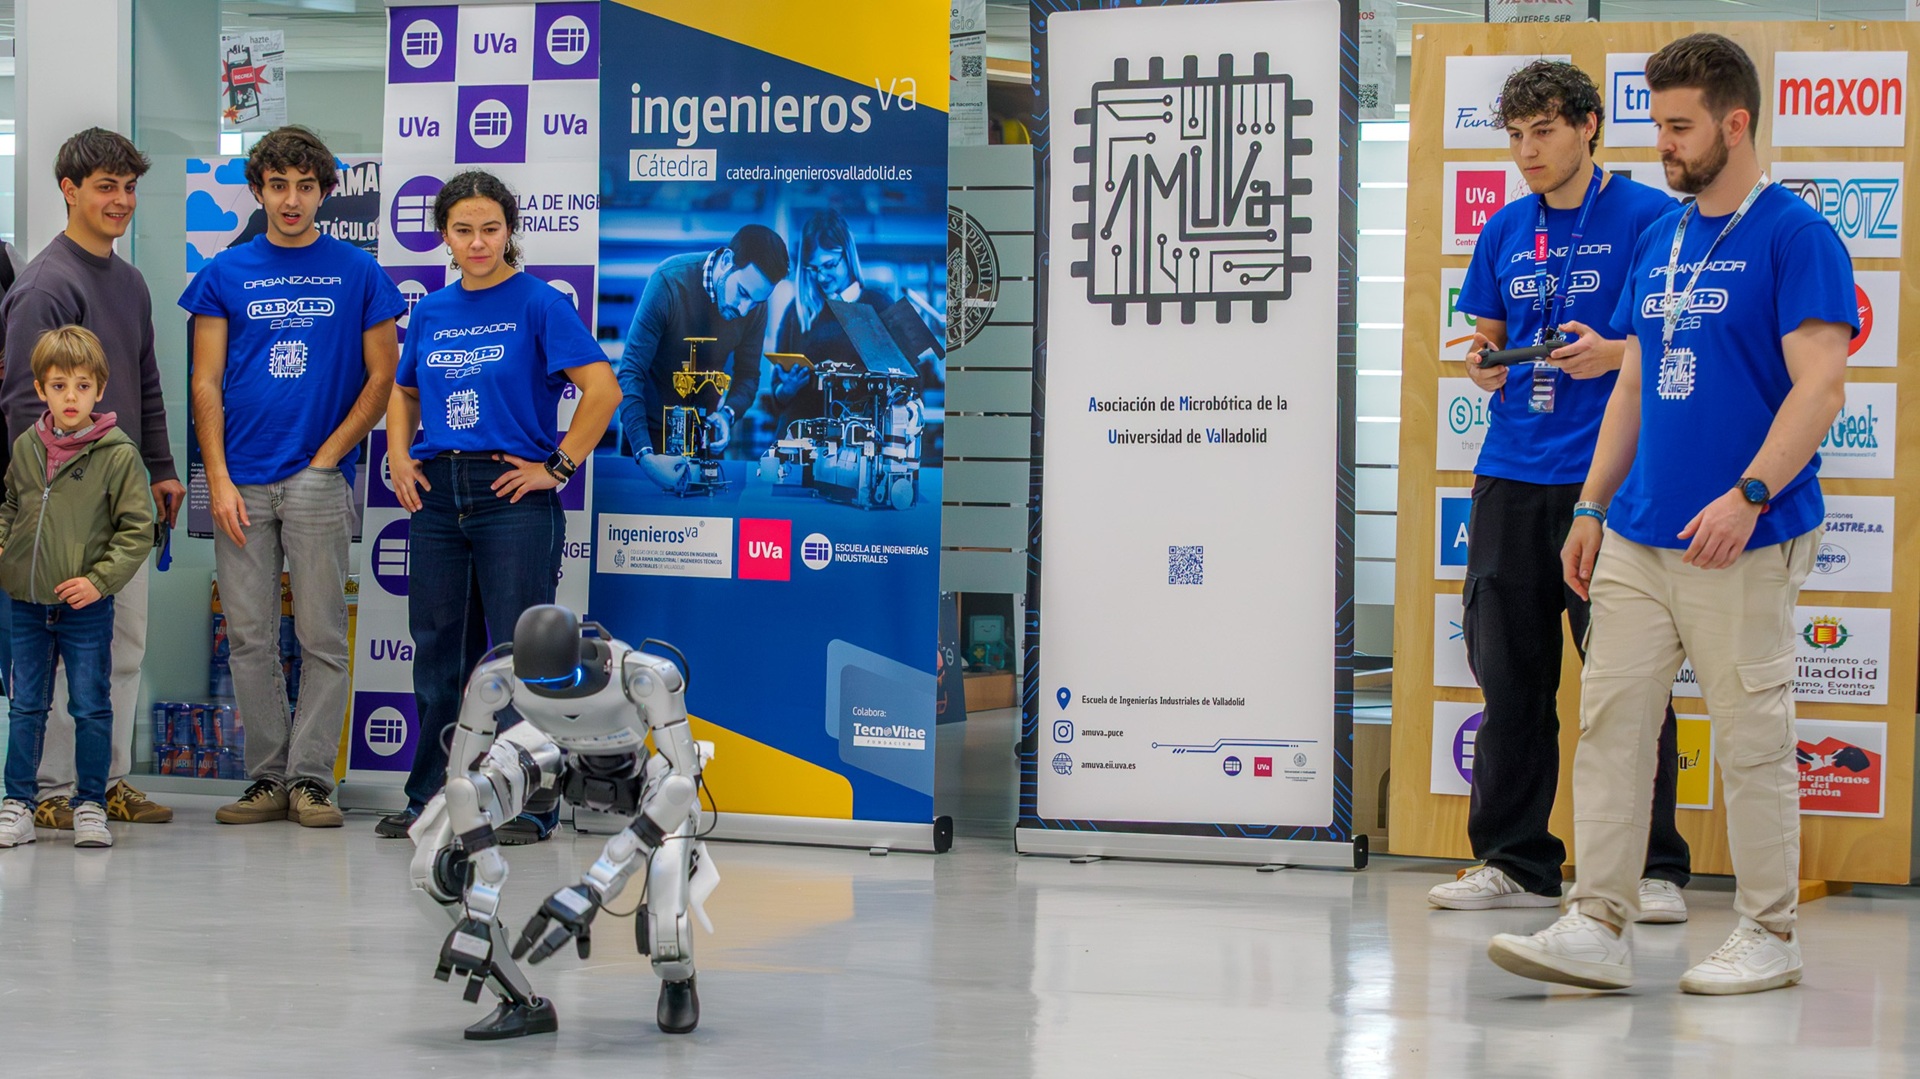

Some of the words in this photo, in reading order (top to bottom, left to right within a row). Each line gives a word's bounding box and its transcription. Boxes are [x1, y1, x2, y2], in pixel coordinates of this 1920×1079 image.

[473, 33, 517, 54] UVa
[1778, 77, 1902, 116] maxon
[399, 117, 440, 137] UVa
[543, 114, 588, 135] UVa
[637, 153, 708, 178] Cátedra
[726, 165, 912, 184] catedra.ingenierosvalladolid.es
[543, 195, 563, 210] DE
[1465, 187, 1496, 204] UVa
[1472, 210, 1487, 227] IA
[243, 276, 341, 290] ORGANIZADOR
[270, 317, 314, 330] 2026
[433, 322, 517, 341] ORGANIZADOR
[444, 364, 482, 379] 2026
[1088, 396, 1156, 412] Asociación
[1160, 396, 1175, 411] de
[1179, 395, 1252, 411] Microbótica
[1257, 395, 1273, 410] de
[1277, 395, 1288, 410] la
[1108, 428, 1183, 444] Universidad
[1186, 428, 1202, 443] de
[1206, 427, 1268, 443] Valladolid
[608, 524, 685, 545] ingenieros
[749, 541, 783, 559] UVa
[835, 543, 869, 553] ESCUELA
[871, 544, 881, 554] DE
[882, 544, 929, 555] INGENIERÍAS
[835, 553, 888, 564] INDUSTRIALES
[369, 639, 413, 661] UVa
[1798, 665, 1878, 680] lladolid
[1827, 681, 1875, 690] Eventos
[1827, 688, 1871, 696] Ciudad
[1081, 695, 1107, 705] Escuela
[1109, 696, 1118, 705] de
[1119, 695, 1158, 707] Ingenierías
[1160, 696, 1200, 706] Industriales
[1201, 697, 1210, 706] de
[1212, 697, 1245, 707] Valladolid
[852, 706, 887, 717] Colabora:
[1081, 760, 1136, 771] amuva.eii.uva.es
[1256, 763, 1270, 771] UVa
